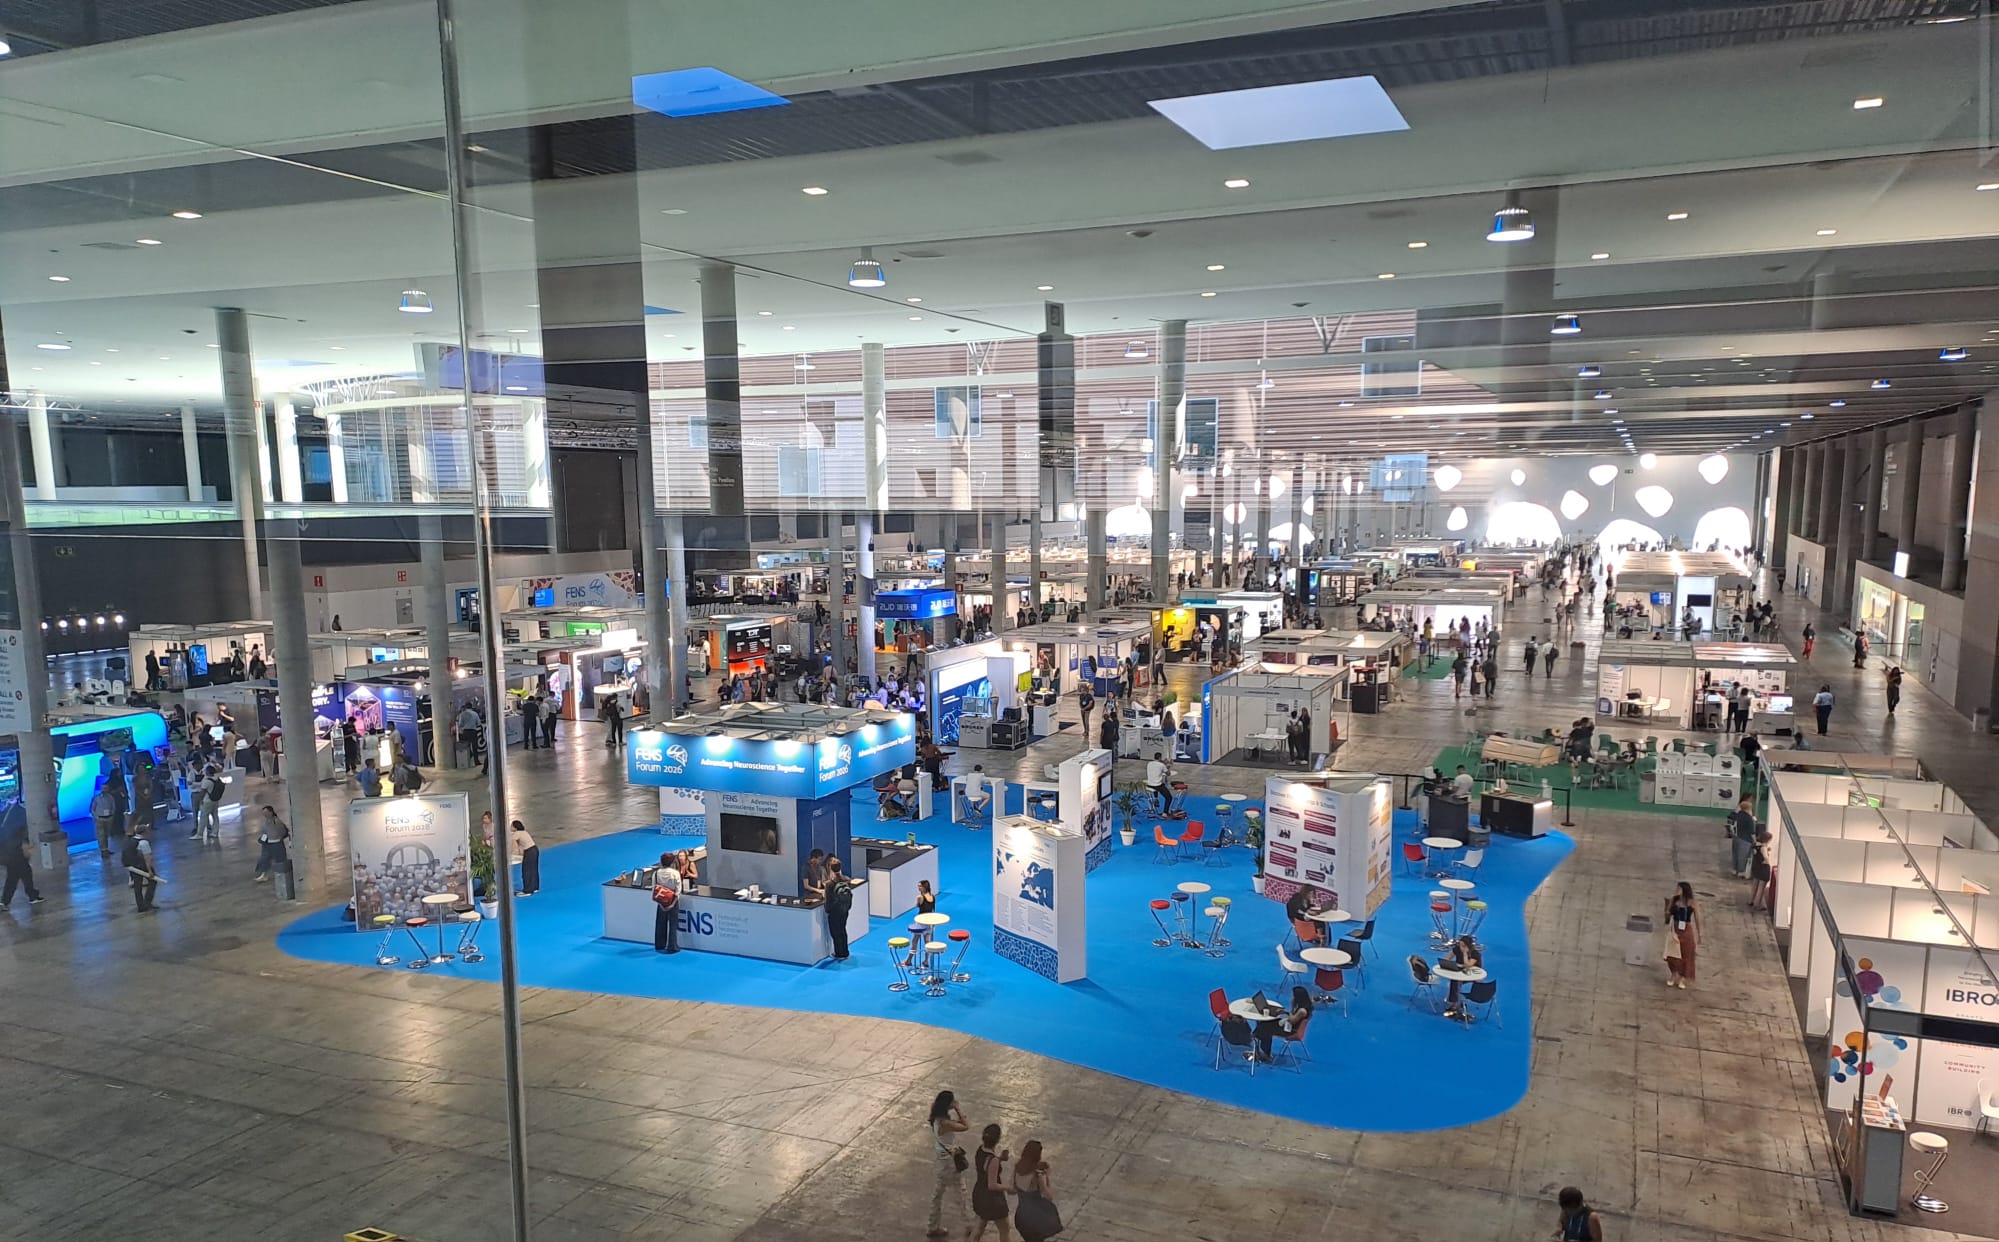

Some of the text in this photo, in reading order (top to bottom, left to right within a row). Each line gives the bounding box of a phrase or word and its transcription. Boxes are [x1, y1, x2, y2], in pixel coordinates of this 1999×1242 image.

[566, 586, 586, 598] FENS
[635, 747, 663, 762] FENS
[636, 763, 683, 774] Forum 2026
[701, 758, 806, 774] Advancing Neuroscience Together
[722, 794, 778, 808] FENS Advancing
[756, 805, 778, 813] Together
[385, 814, 410, 825] FENS
[385, 825, 411, 833] Forum
[676, 909, 714, 936] ENS
[1943, 1060, 1986, 1069] COMMUNITY
[1947, 1066, 1981, 1075] BUILDING
